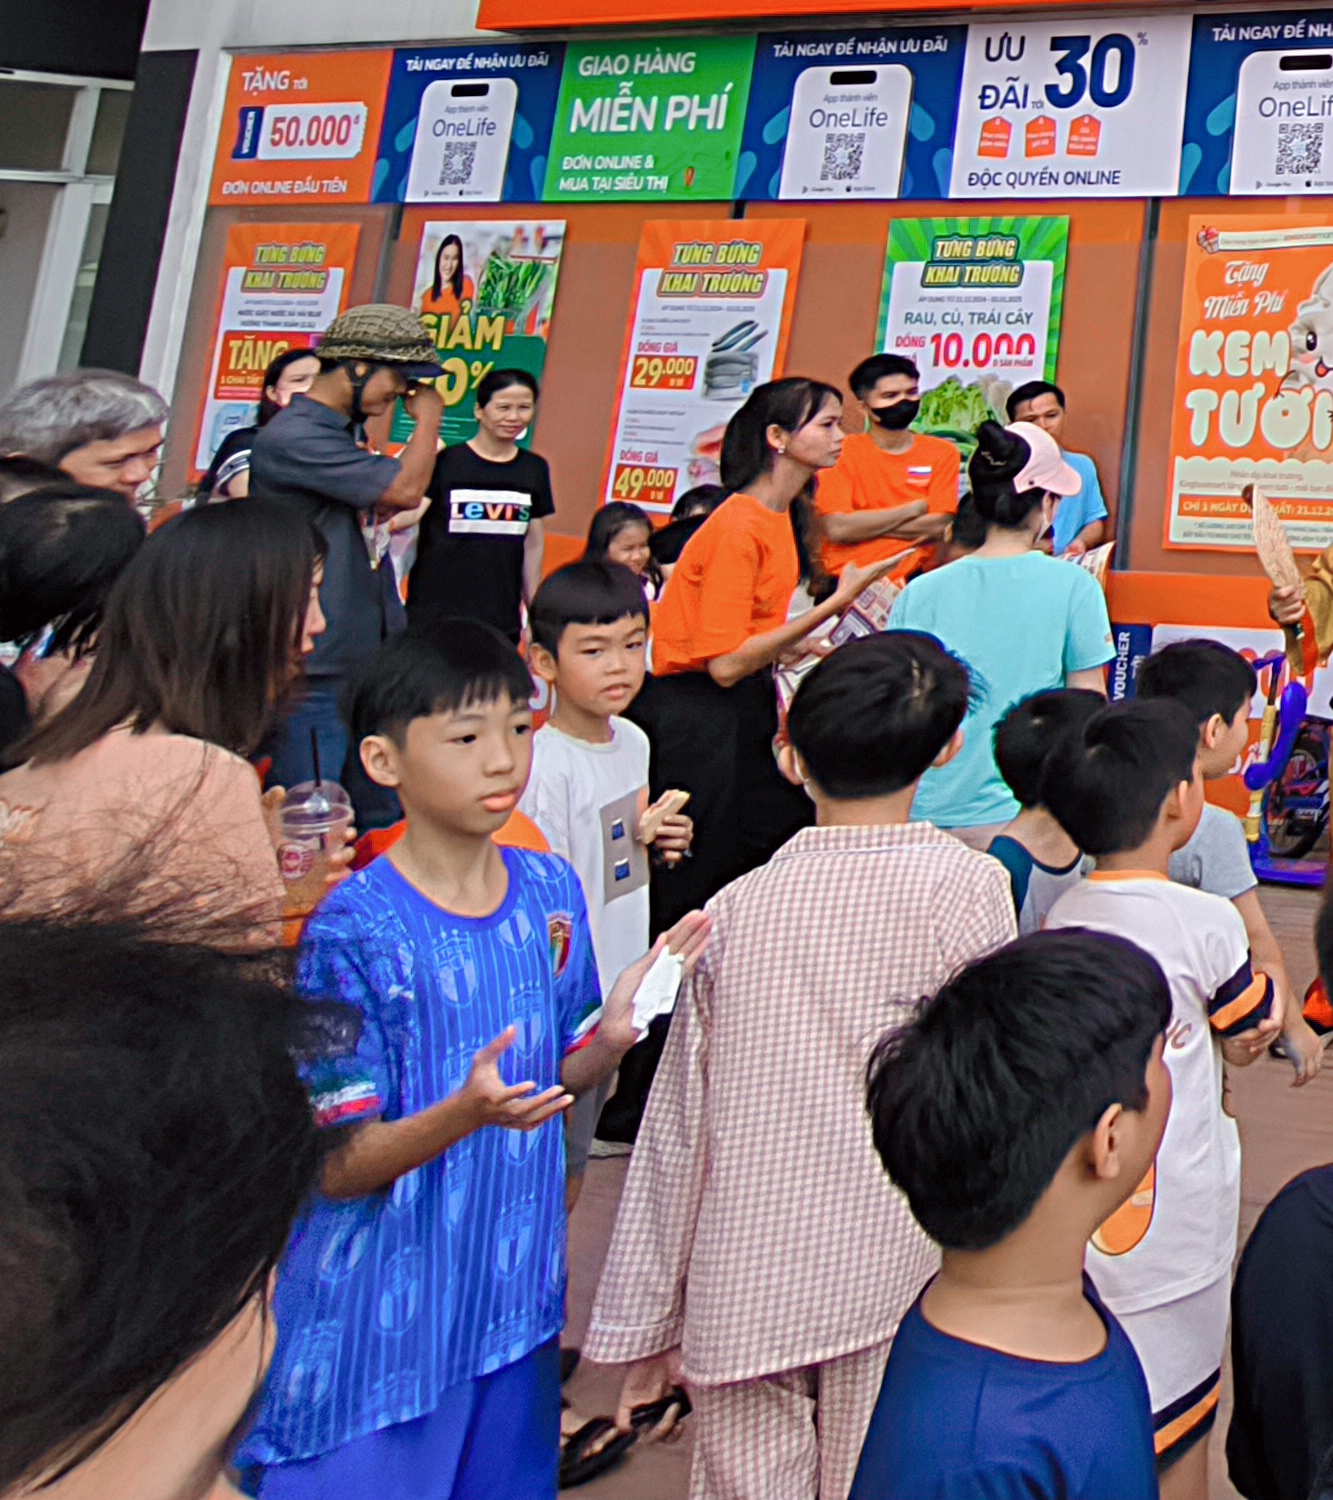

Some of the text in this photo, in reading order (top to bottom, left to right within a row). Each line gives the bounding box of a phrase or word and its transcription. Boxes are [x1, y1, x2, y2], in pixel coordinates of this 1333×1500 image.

[1212, 23, 1236, 42] TẢI
[1239, 26, 1281, 40] NGAY
[773, 41, 794, 58] TẢI
[796, 43, 833, 57] NGAY
[857, 37, 898, 58] NHẬN
[899, 39, 920, 54] ƯU
[922, 36, 949, 53] ĐÃI
[985, 31, 1027, 63] ƯU
[578, 48, 696, 77] GIAO HÀNG
[242, 66, 291, 96] TẶNG
[978, 76, 1030, 111] ĐÃI
[570, 82, 734, 133] MIỄN PHÍ
[808, 107, 889, 128] OneLife
[432, 117, 497, 137] OneLife
[595, 155, 643, 170] ONLINE
[251, 180, 293, 195] ONLINE
[559, 177, 587, 192] MUA
[968, 166, 1121, 190] ĐỘC QUYỀN ONLINE
[661, 273, 698, 293] KHAI
[925, 265, 960, 284] KHAI
[1224, 260, 1270, 288] Tặng
[904, 308, 1034, 327] RAU, CỦ, TRÁI CÂY
[1189, 329, 1291, 378] KEM
[633, 357, 695, 387] 29.000
[615, 467, 675, 498] 49.000
[1112, 631, 1131, 701] VOUCHER
